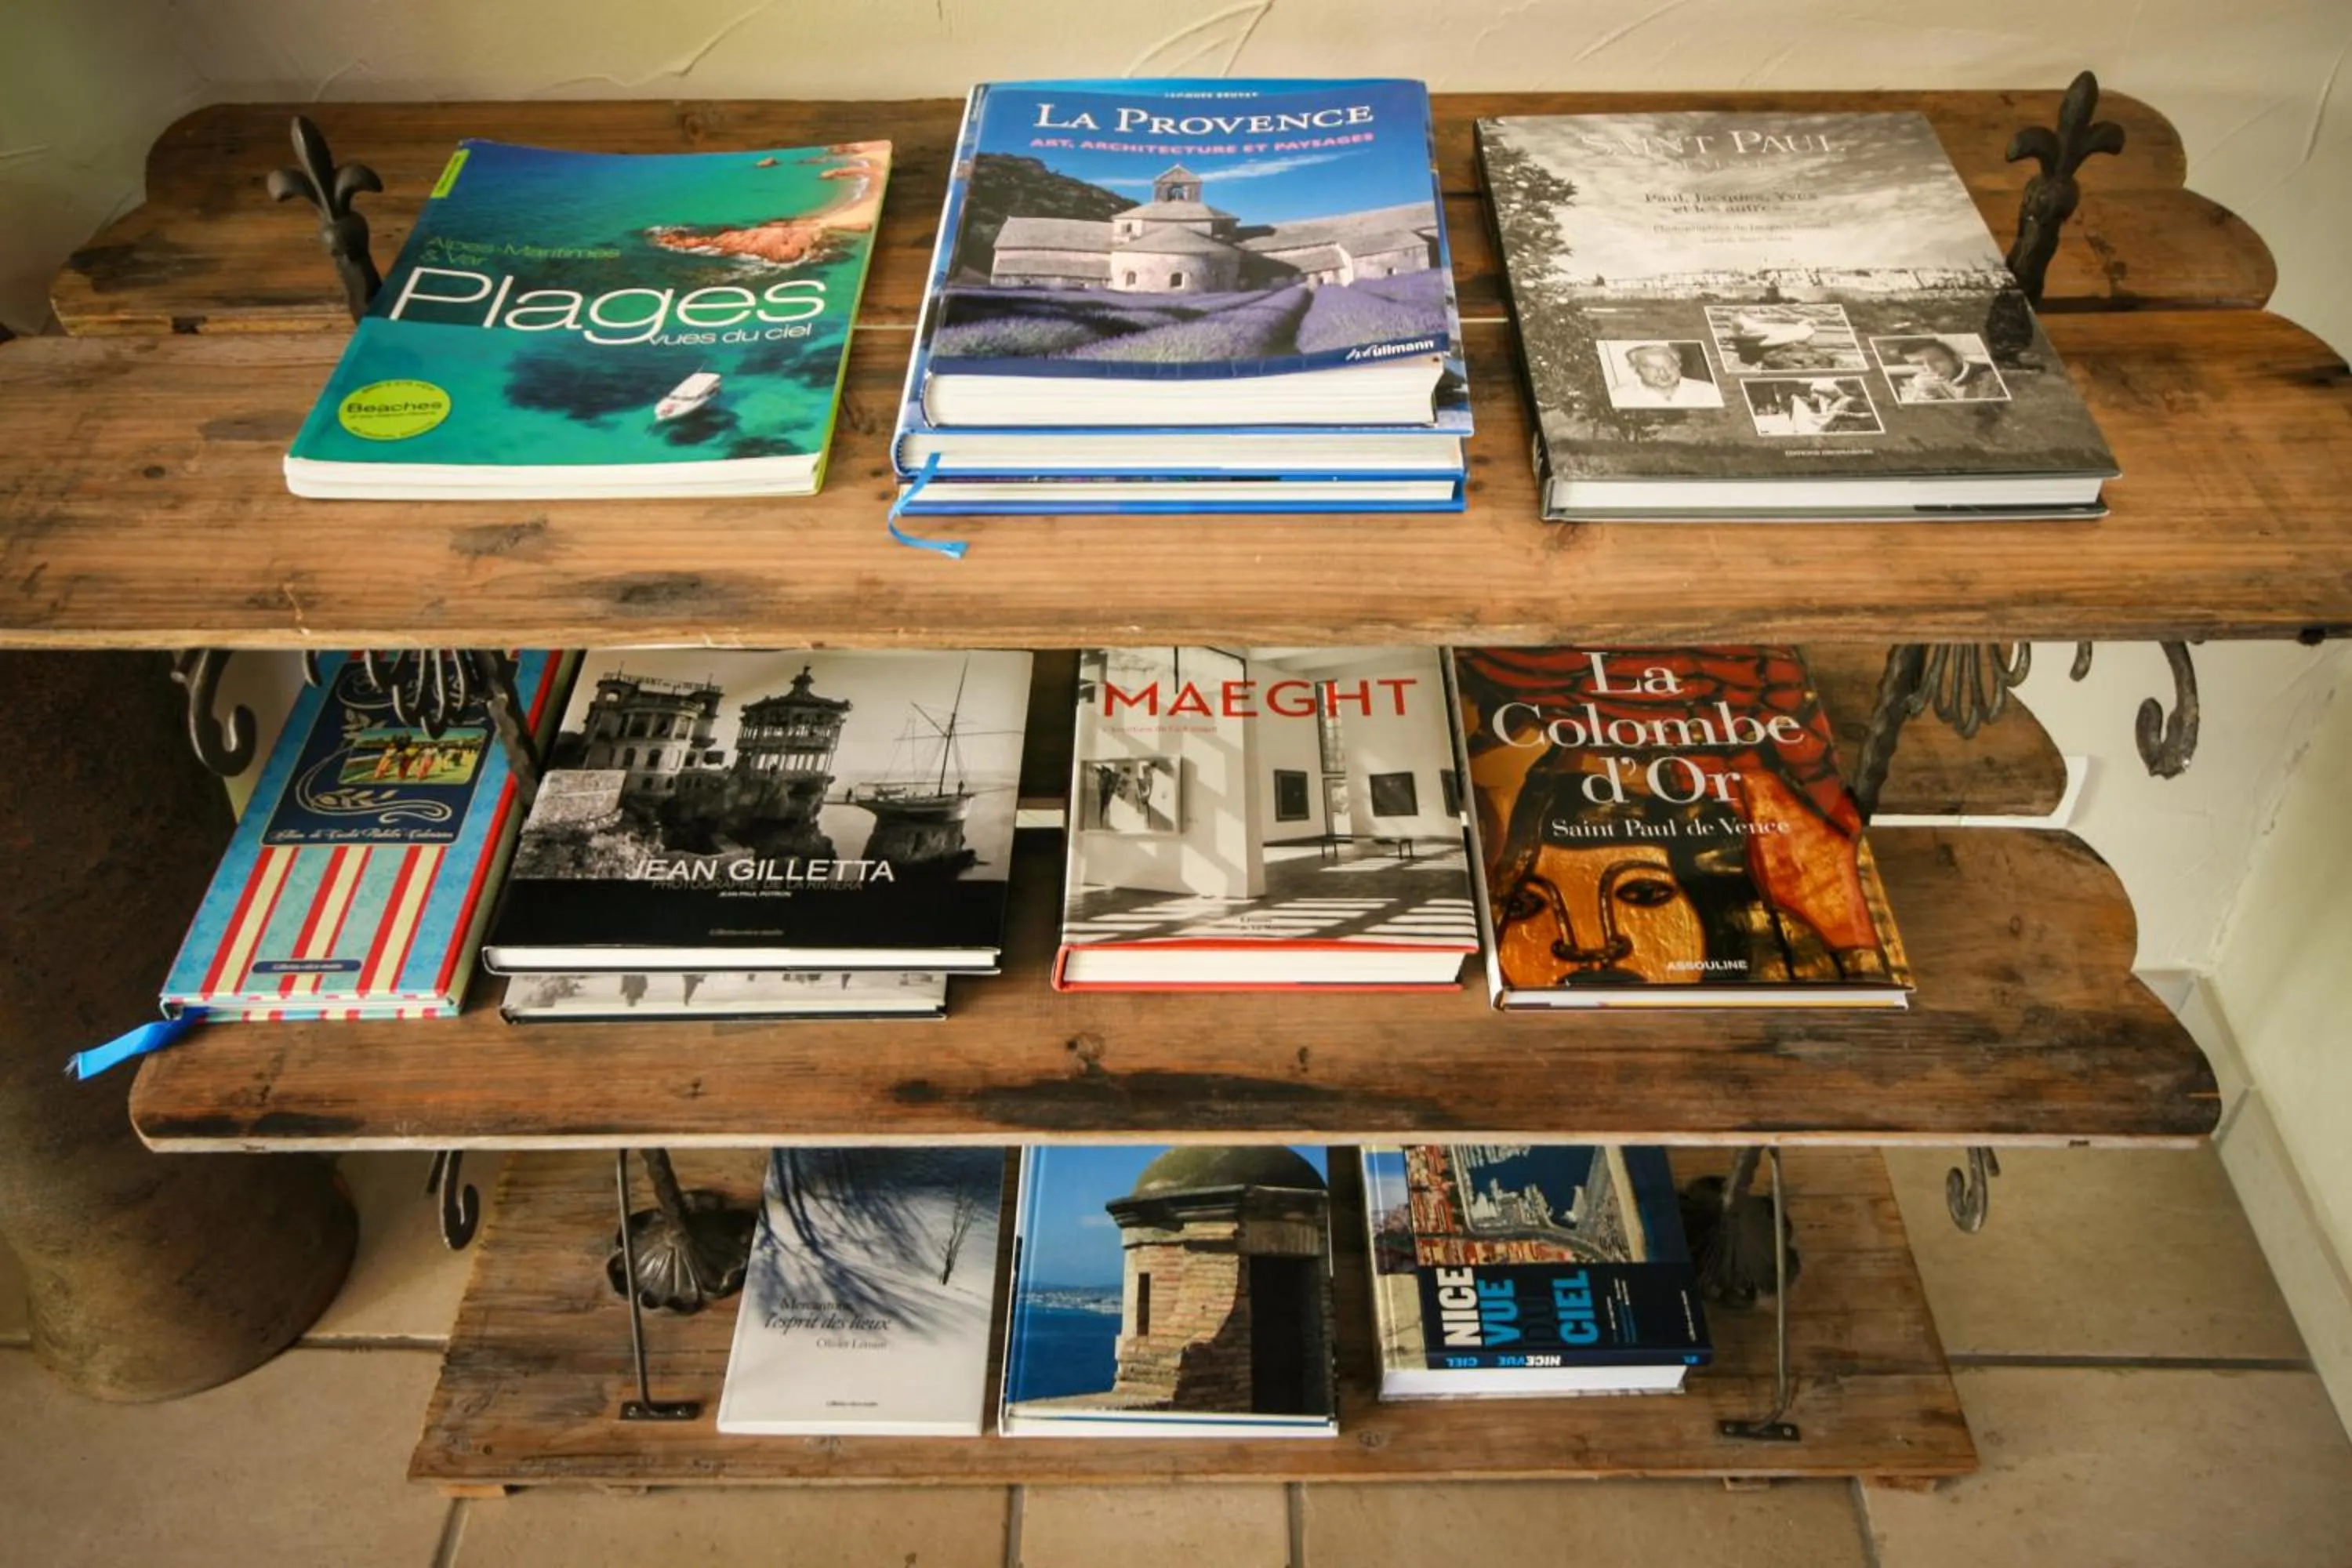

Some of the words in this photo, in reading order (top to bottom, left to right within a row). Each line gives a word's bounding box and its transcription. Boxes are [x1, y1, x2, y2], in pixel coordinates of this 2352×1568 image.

[1033, 103, 1100, 130] LA
[1114, 105, 1374, 135] PROVENCE
[1030, 138, 1075, 149] ART,
[1080, 140, 1237, 155] ARCHITECTURE
[1243, 143, 1268, 154] ET
[1274, 132, 1374, 152] PAYSAGES
[1728, 129, 1846, 154] PAUL
[389, 267, 827, 346] Plages
[649, 332, 716, 347] vues
[722, 327, 760, 343] du
[765, 322, 813, 341] ciel
[347, 401, 443, 413] Beaches
[1581, 652, 1685, 695] La
[1103, 678, 1418, 718] MAEGHT
[1491, 700, 1806, 749] Colombe
[1581, 756, 1744, 804] d'Or
[1552, 818, 1615, 838] Saint
[1624, 818, 1678, 837] Paul
[1686, 818, 1715, 837] de
[1718, 816, 1791, 836] Vence
[625, 858, 718, 881] JEAN
[728, 858, 896, 883] GILLETTA
[652, 878, 760, 891] PHOTOGRAPHE
[1667, 959, 1749, 971] ASSOULINE
[1436, 1266, 1483, 1347] NICE
[1476, 1278, 1521, 1346] VUE
[1552, 1269, 1599, 1345] CIEL
[821, 1312, 845, 1330] des
[849, 1313, 892, 1330] lieux
[1446, 1356, 1479, 1367] CIEL
